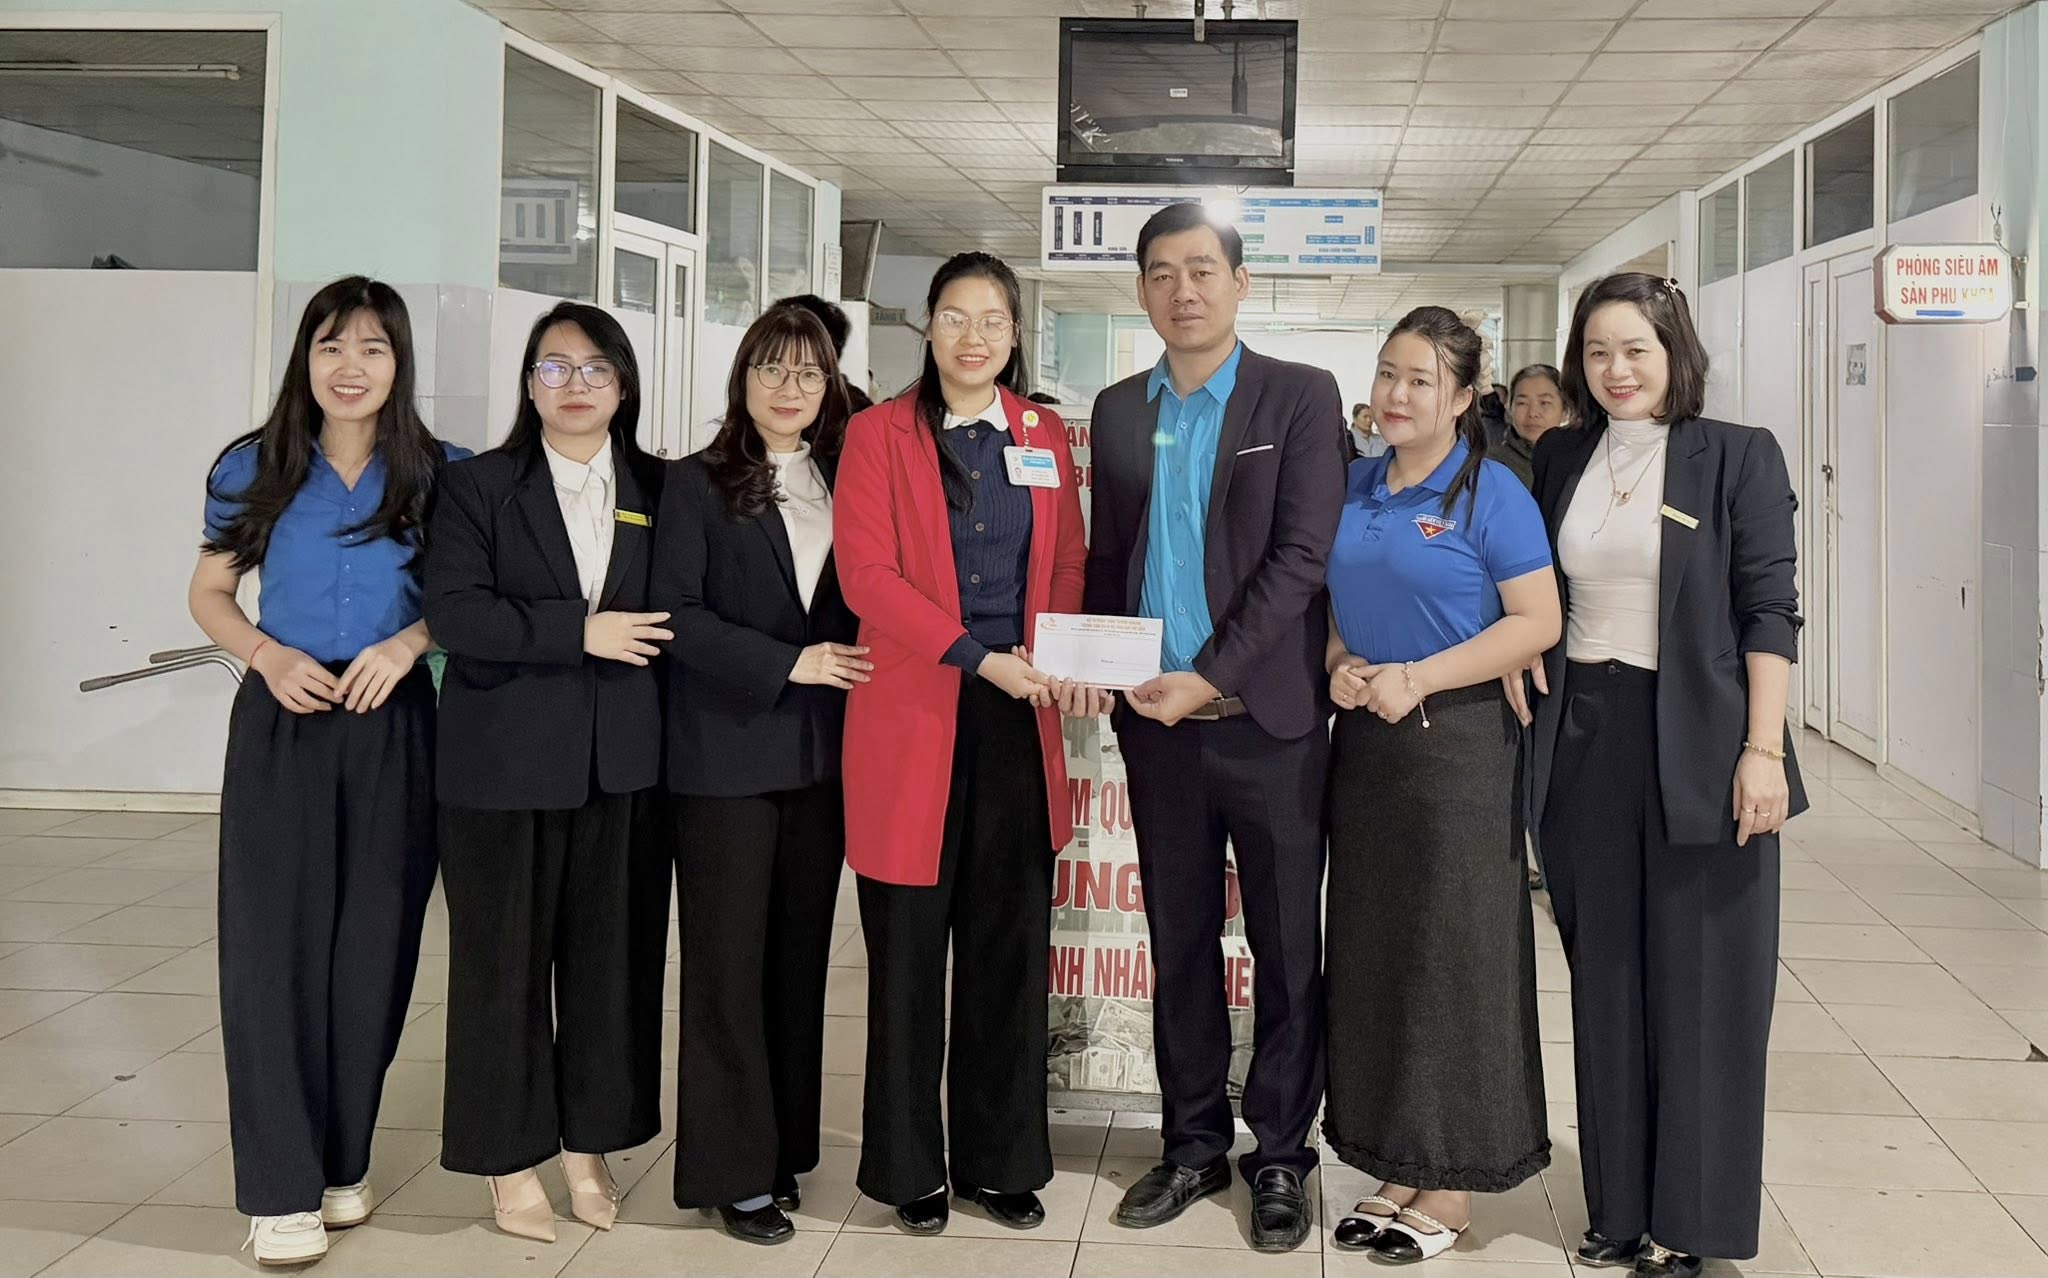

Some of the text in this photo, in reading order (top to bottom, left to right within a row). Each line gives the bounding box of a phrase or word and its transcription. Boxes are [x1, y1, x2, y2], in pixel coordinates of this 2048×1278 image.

[1897, 254, 1940, 276] PHÒNG
[1978, 255, 1999, 276] ÂM
[1069, 778, 1133, 836] M QU
[1052, 859, 1145, 913] UNG
[1049, 945, 1085, 996] NH
[1093, 940, 1156, 999] NHÂ
